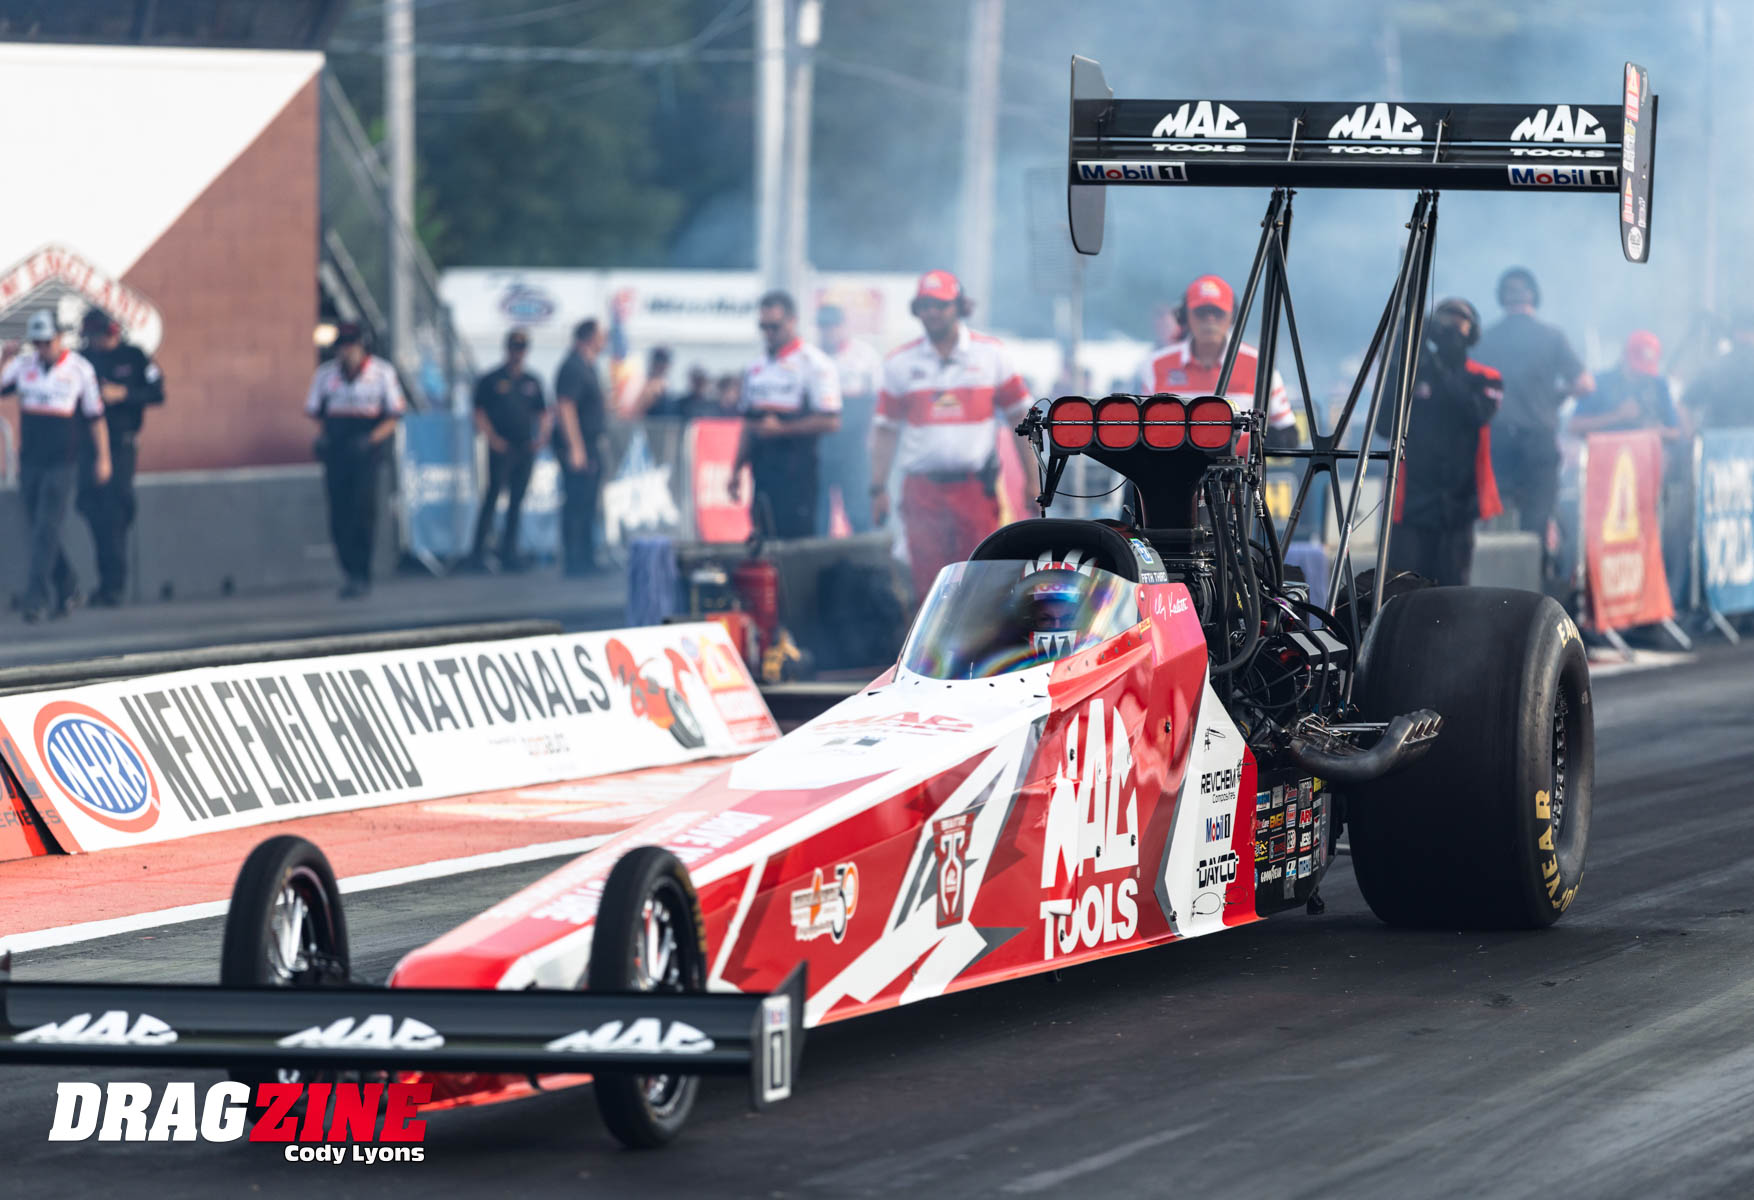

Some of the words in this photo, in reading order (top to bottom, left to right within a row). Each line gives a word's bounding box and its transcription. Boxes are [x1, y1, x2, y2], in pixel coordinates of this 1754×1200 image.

[1152, 101, 1247, 138] MAC
[1328, 103, 1424, 141] MAC
[1510, 105, 1606, 143] MAC
[1152, 143, 1247, 152] TOOLS
[1328, 146, 1423, 155] TOOLS
[1510, 148, 1605, 158] TOOLS
[1081, 163, 1155, 181] Mobil
[1511, 167, 1585, 186] Mobil
[382, 644, 611, 735] NATIONALS
[50, 722, 147, 810] NHRA
[1201, 768, 1236, 795] REVCHEM
[1041, 698, 1139, 889] MAC
[1206, 815, 1224, 843] Mobil
[1198, 852, 1236, 888] DAYCO
[1039, 878, 1139, 961] TOOLS
[10, 1010, 179, 1046] MAC
[275, 1014, 446, 1049] MAC
[543, 1018, 716, 1054] MAC
